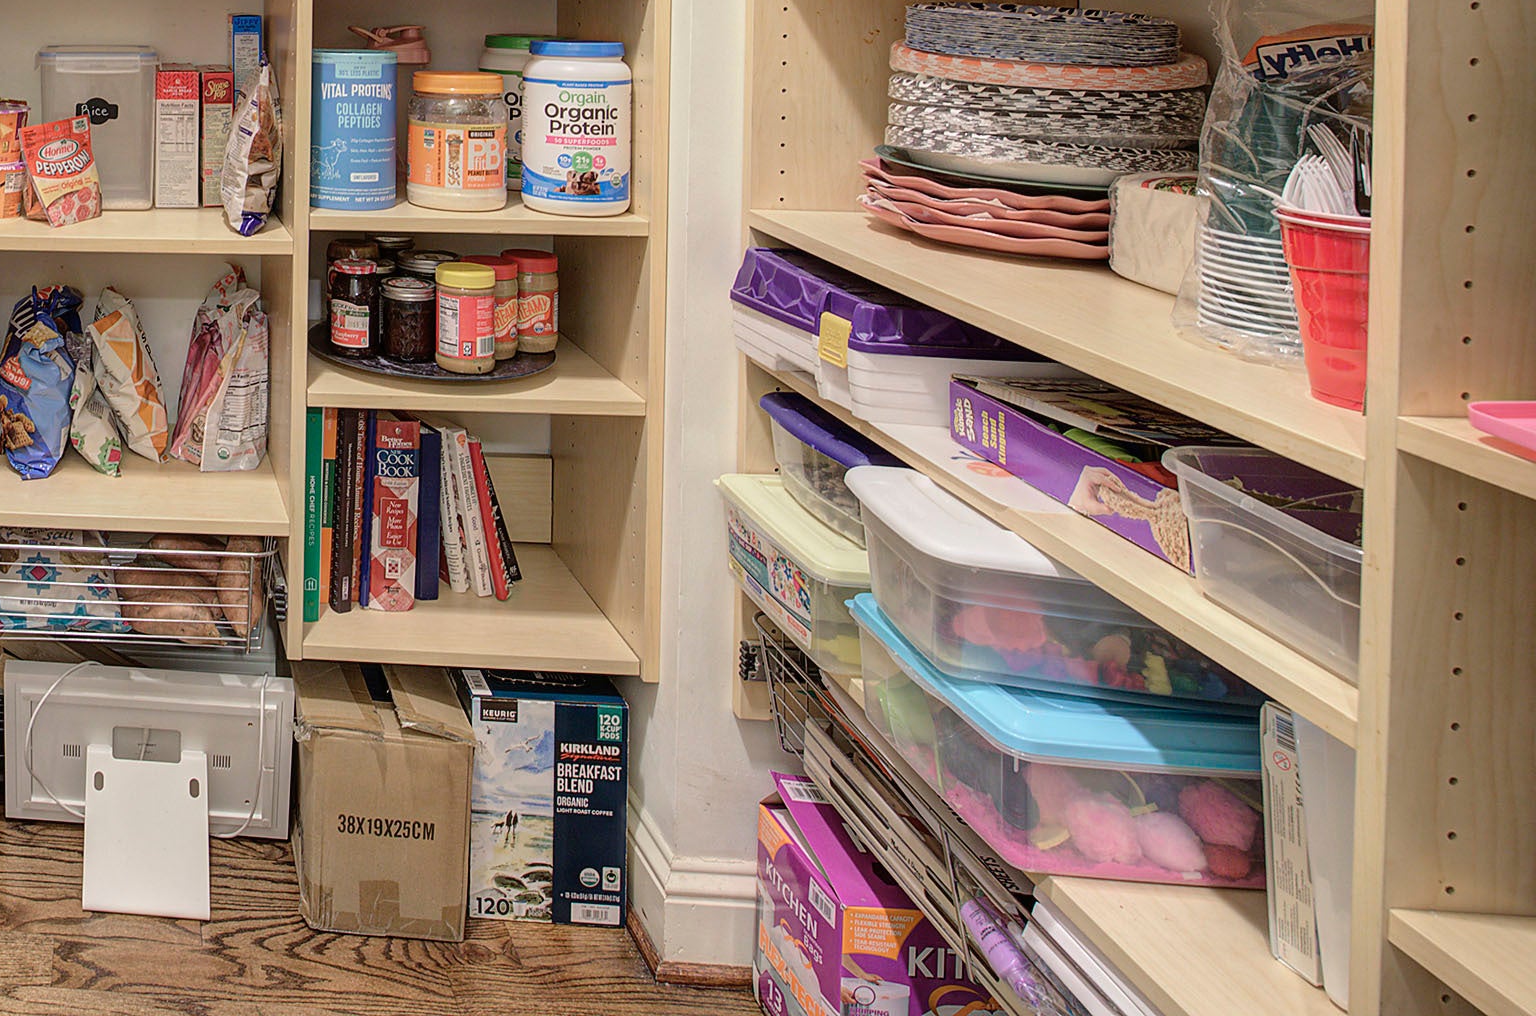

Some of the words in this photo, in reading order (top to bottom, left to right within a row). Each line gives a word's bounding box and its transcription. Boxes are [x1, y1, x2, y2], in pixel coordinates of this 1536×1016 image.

[321, 83, 348, 100] VITAL
[351, 83, 392, 101] PROTEINS
[558, 90, 606, 107] Orgain
[81, 103, 110, 117] Rice
[336, 102, 383, 116] COLLAGEN
[544, 103, 619, 123] Organic
[338, 115, 381, 129] PEPTIDES
[550, 119, 615, 136] Protein
[563, 138, 610, 146] SUPERFOODS
[44, 143, 75, 159] Hormel
[35, 149, 91, 175] PEPPERONI
[467, 169, 484, 177] PEANUT
[981, 410, 990, 449] Beach
[989, 418, 998, 449] Sand
[381, 435, 404, 443] Better
[387, 440, 413, 448] Homes
[997, 410, 1007, 466] Kingdom
[376, 449, 414, 465] COOK
[377, 463, 414, 477] BOOK
[308, 475, 316, 494] HOME
[308, 494, 316, 510] CHEF
[388, 501, 402, 509] New
[386, 507, 404, 515] Recipes
[387, 516, 403, 525] More
[308, 510, 316, 546] RECIPES
[393, 537, 403, 546] Use
[482, 709, 517, 719] KEURIG
[599, 714, 621, 726] 120
[599, 725, 620, 733] K-CUP
[599, 732, 620, 740] PODS
[560, 742, 620, 756] KIRKLAND
[560, 752, 620, 763] Signature
[557, 762, 622, 781] BREAKFAST
[557, 778, 594, 794] BLEND
[556, 796, 589, 808] ORGANIC
[573, 808, 590, 816] ROAST
[591, 809, 613, 817] COFFEE
[336, 813, 436, 842] 38X19X25CM
[764, 856, 818, 940] KITCHEN
[475, 896, 510, 916] 120
[853, 919, 878, 927] FLEXIBLE
[854, 911, 889, 921] EXPANDABLE
[889, 915, 915, 923] CAPACITY
[803, 936, 824, 965] Bags
[853, 944, 890, 954] TECHNOLOGY
[766, 978, 782, 1012] 13
